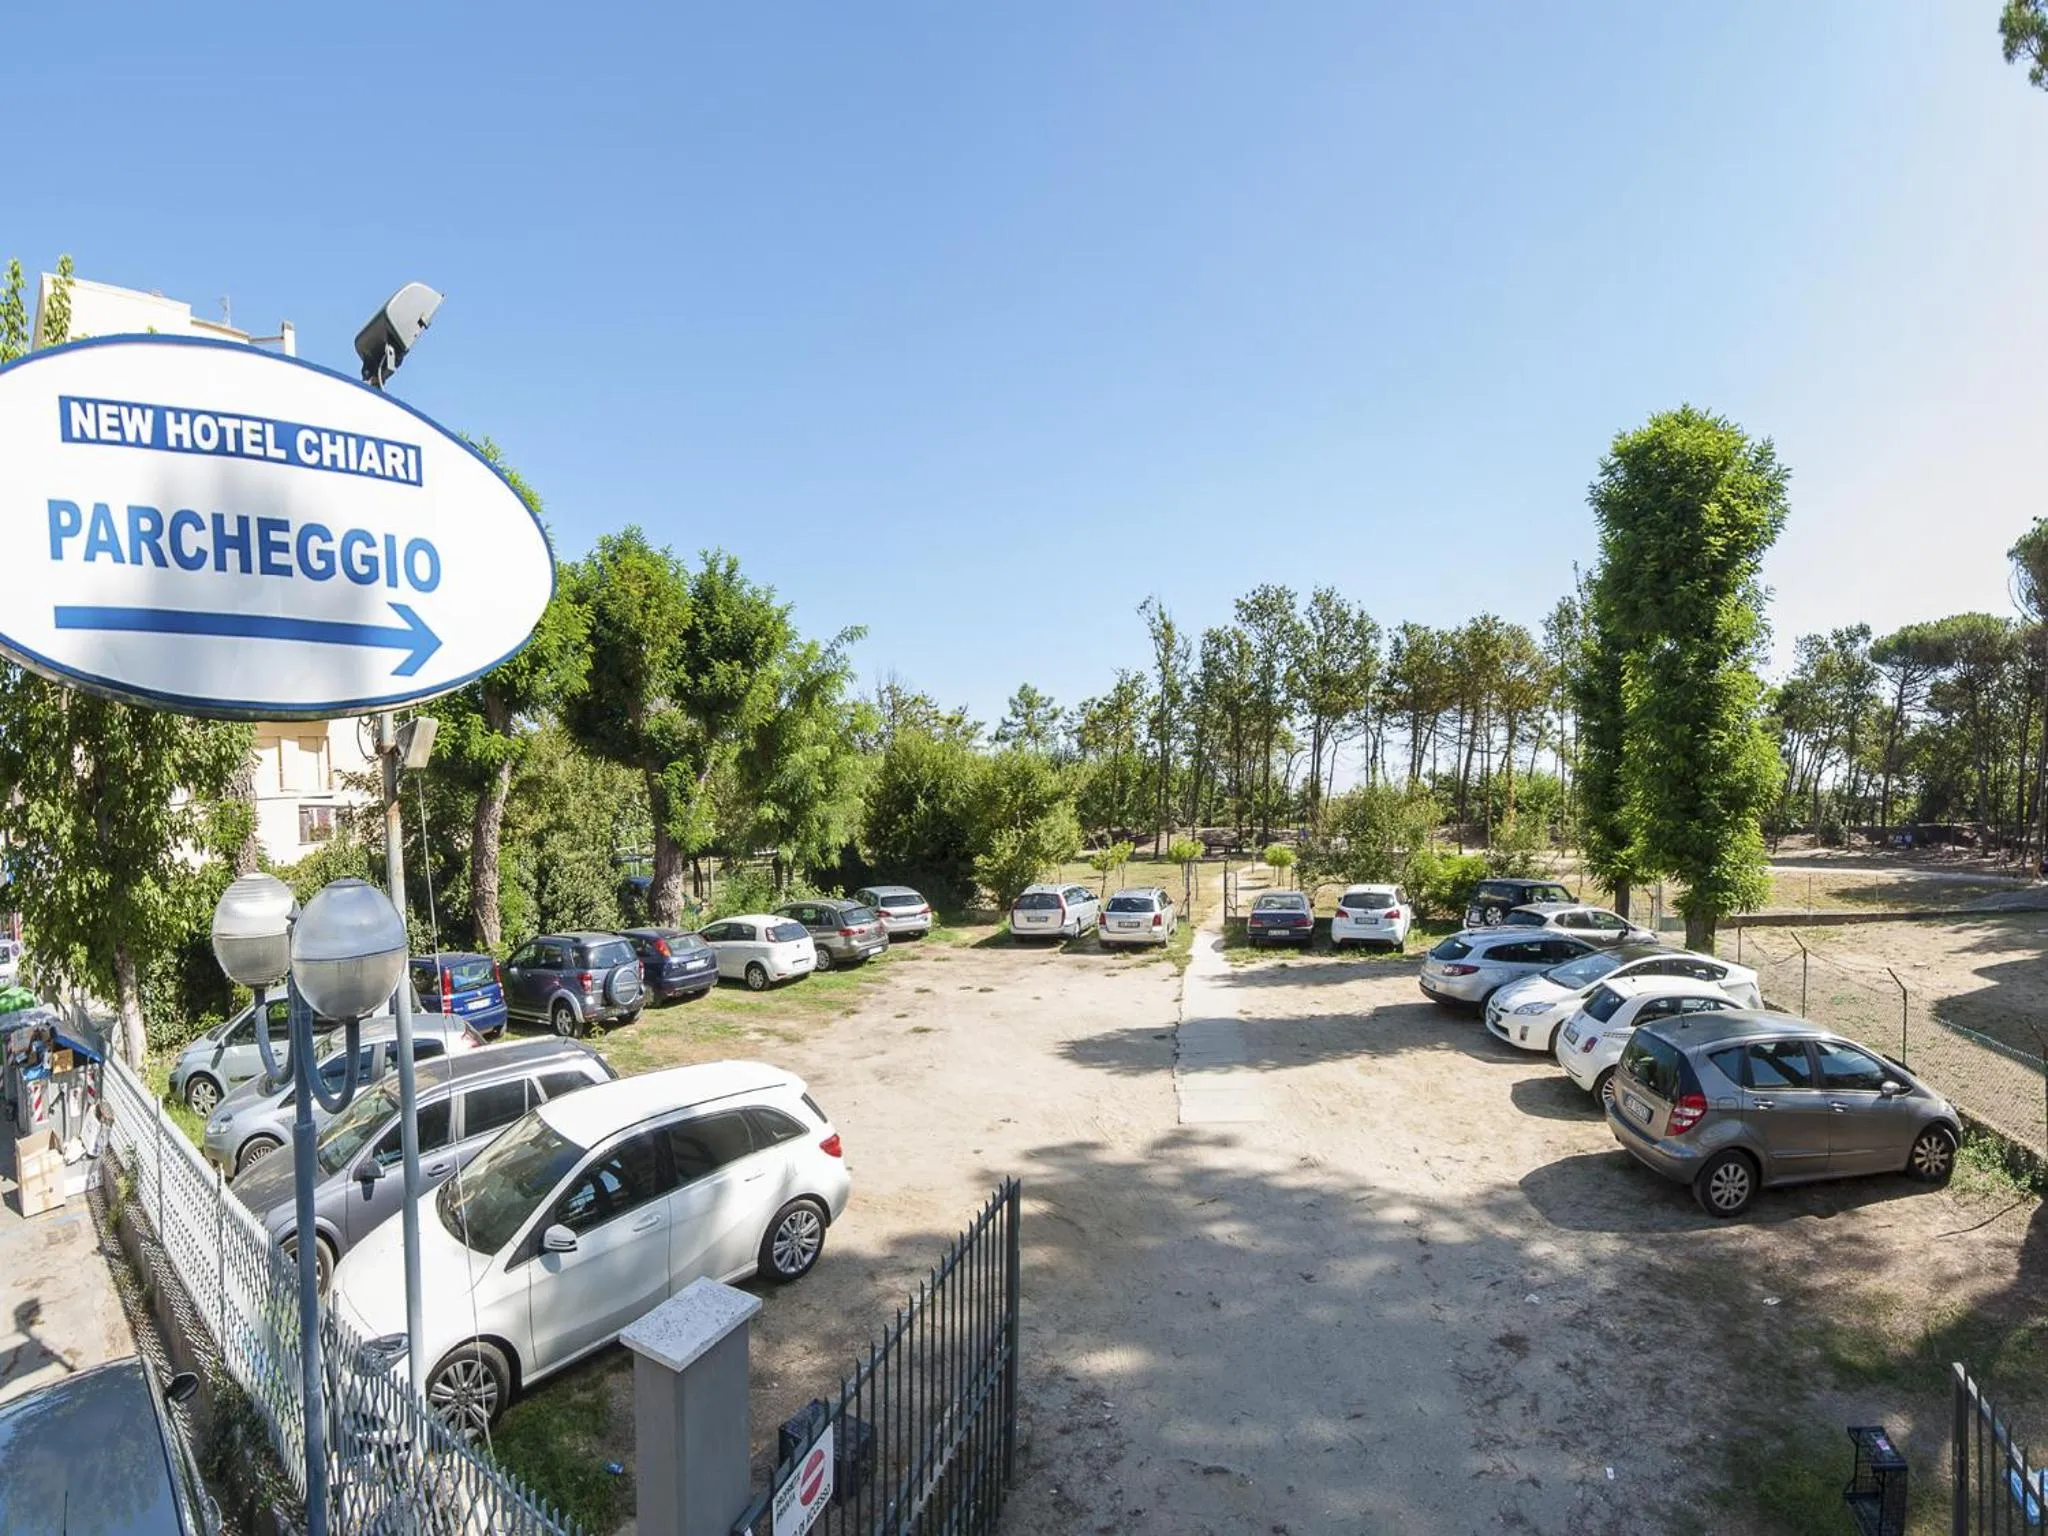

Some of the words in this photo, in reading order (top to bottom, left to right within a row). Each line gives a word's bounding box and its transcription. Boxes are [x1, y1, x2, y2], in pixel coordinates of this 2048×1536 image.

[69, 401, 154, 444] NEW
[165, 411, 288, 461] HOTEL
[296, 436, 418, 481] CHIARI
[47, 498, 442, 593] PARCHEGGIO
